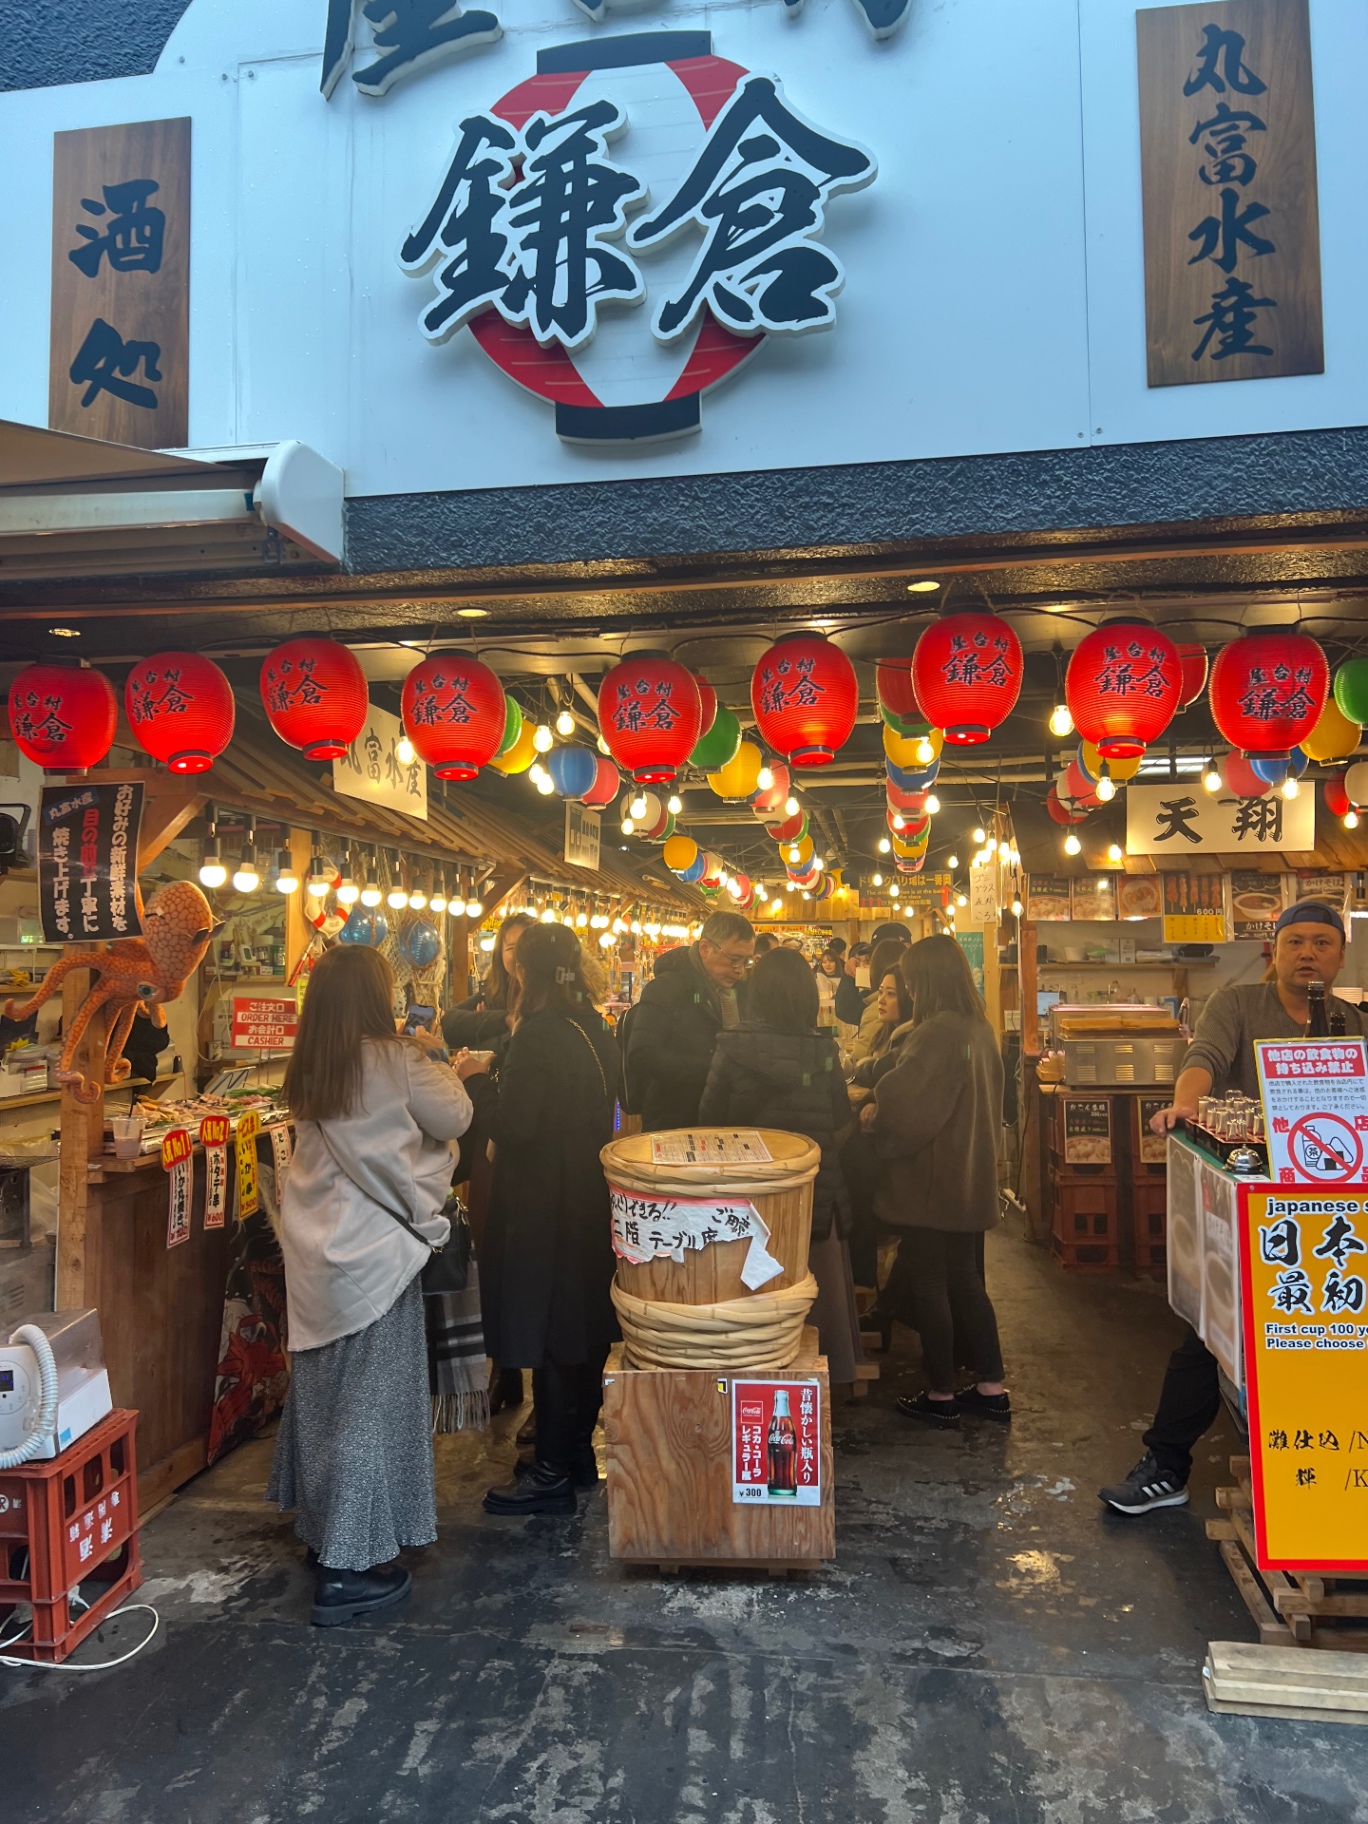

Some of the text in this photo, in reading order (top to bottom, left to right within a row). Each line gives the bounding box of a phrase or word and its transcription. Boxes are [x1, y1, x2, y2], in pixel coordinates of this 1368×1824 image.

[1183, 23, 1278, 362] 丸富水産
[399, 76, 873, 341] 鎌倉
[68, 177, 167, 410] 酒処
[951, 631, 1009, 654] 屋台村
[1104, 641, 1166, 665] 屋台村
[415, 673, 470, 696] 屋台村
[762, 658, 816, 686] 屋台村
[941, 653, 1014, 687] 鎌倉
[1094, 664, 1171, 698] 鎌倉
[1249, 663, 1312, 687] 屋台村
[131, 684, 195, 725] 鎌倉
[268, 674, 329, 714] 鎌倉
[616, 678, 673, 702] 屋台村
[759, 675, 825, 715] 鎌倉
[1238, 687, 1316, 720] 鎌倉
[410, 693, 478, 727] 鎌倉
[612, 699, 681, 732] 鎌倉
[12, 712, 73, 742] 鎌倉
[1156, 796, 1283, 844] 天翔
[79, 808, 99, 932] 目の前で丁寧に
[110, 785, 133, 932] お好みの新鮮素材を
[52, 827, 74, 940] 焼き上げます。
[241, 1013, 269, 1022] ORDER
[272, 1014, 294, 1023] HERE
[249, 1002, 285, 1012] ご注文口
[247, 1036, 284, 1046] CASHIER
[248, 1025, 284, 1035] お会計口
[1267, 1047, 1358, 1062] 他店の飲食物の
[1276, 1061, 1355, 1075] 持ち込み禁止
[1272, 1117, 1290, 1134] 他
[1309, 1146, 1319, 1157] 茶
[1267, 1198, 1358, 1216] japanese
[614, 1219, 640, 1246] 二階
[1260, 1215, 1365, 1267] 日本
[1270, 1271, 1363, 1313] 最初
[1266, 1324, 1297, 1334] First
[1301, 1326, 1326, 1337] cup
[1330, 1324, 1354, 1334] 100
[1267, 1338, 1364, 1348] Please choose
[800, 1388, 813, 1484] 昔懐かしい瓶入り
